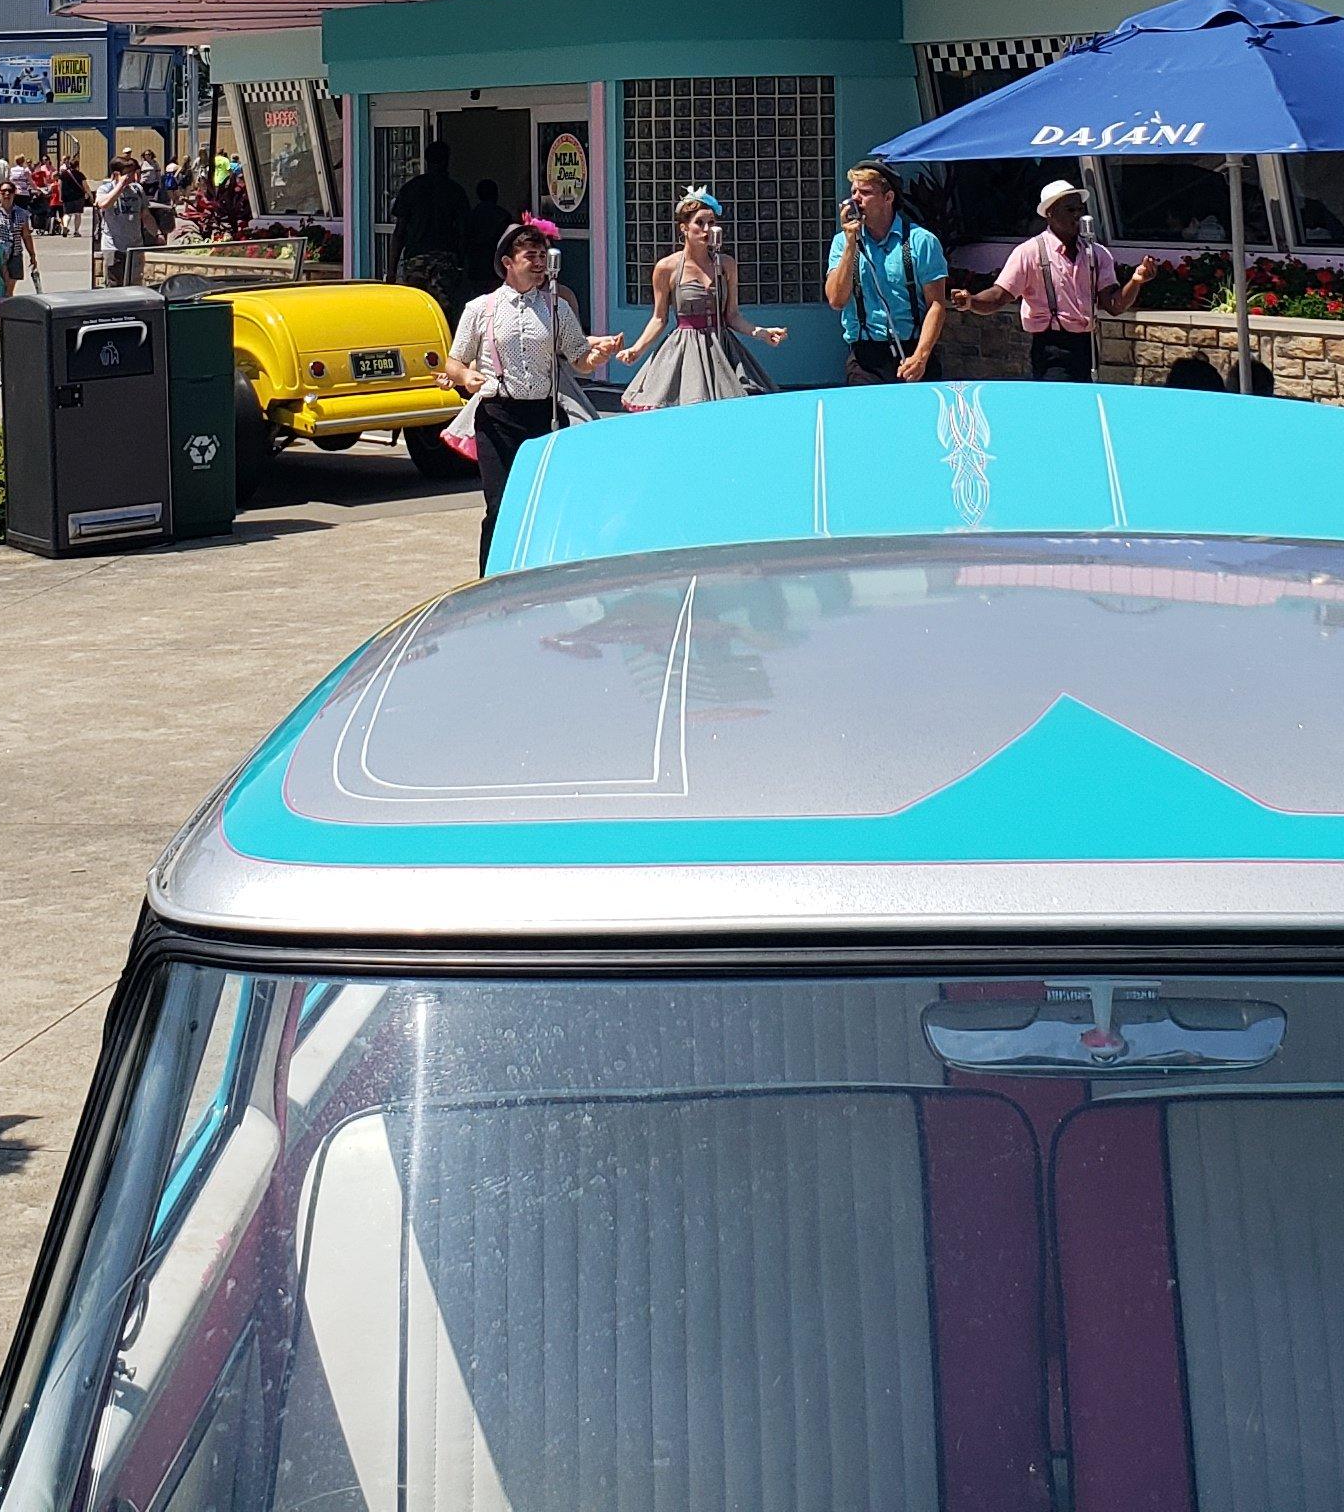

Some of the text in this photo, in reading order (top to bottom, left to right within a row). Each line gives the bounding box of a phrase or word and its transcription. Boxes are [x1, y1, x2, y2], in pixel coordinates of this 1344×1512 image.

[55, 76, 88, 94] IMPACT
[1030, 122, 1205, 150] DASANI
[554, 152, 579, 166] MEAL
[359, 358, 394, 372] 32 FORD
